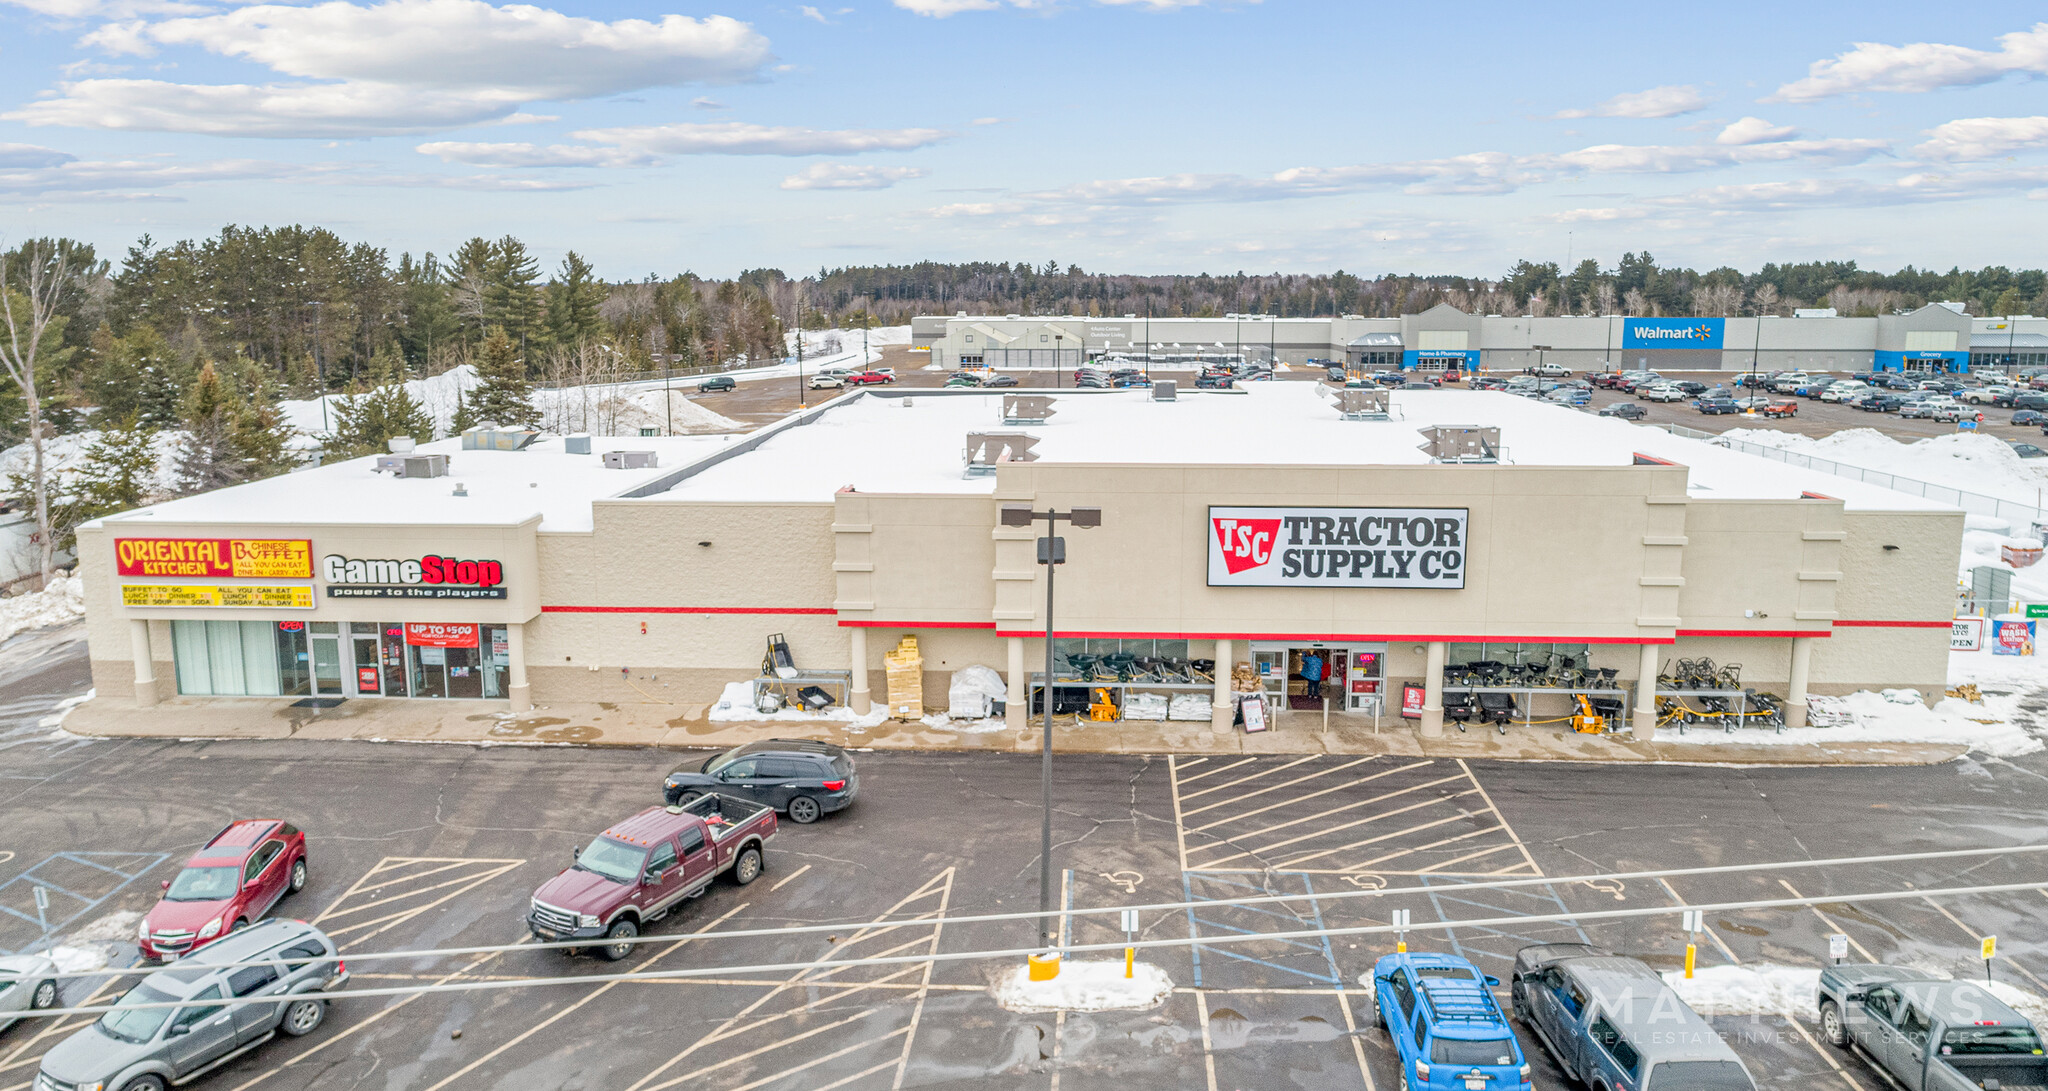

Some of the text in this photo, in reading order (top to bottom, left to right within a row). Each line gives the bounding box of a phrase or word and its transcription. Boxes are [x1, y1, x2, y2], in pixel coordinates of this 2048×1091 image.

[634, 326, 694, 338] Walmart
[1284, 516, 1461, 548] TRACTOR
[251, 542, 290, 550] CHINESE
[1220, 520, 1269, 564] TSC
[118, 540, 230, 570] ORIENTAL
[232, 542, 306, 560] BUFFET
[143, 562, 208, 575] KITCHEN
[323, 554, 503, 587] GameStop
[1282, 549, 1416, 579] SUPPLY
[334, 588, 498, 598] power to the players
[279, 620, 304, 630] OPEN
[410, 624, 472, 634] UP TO $500
